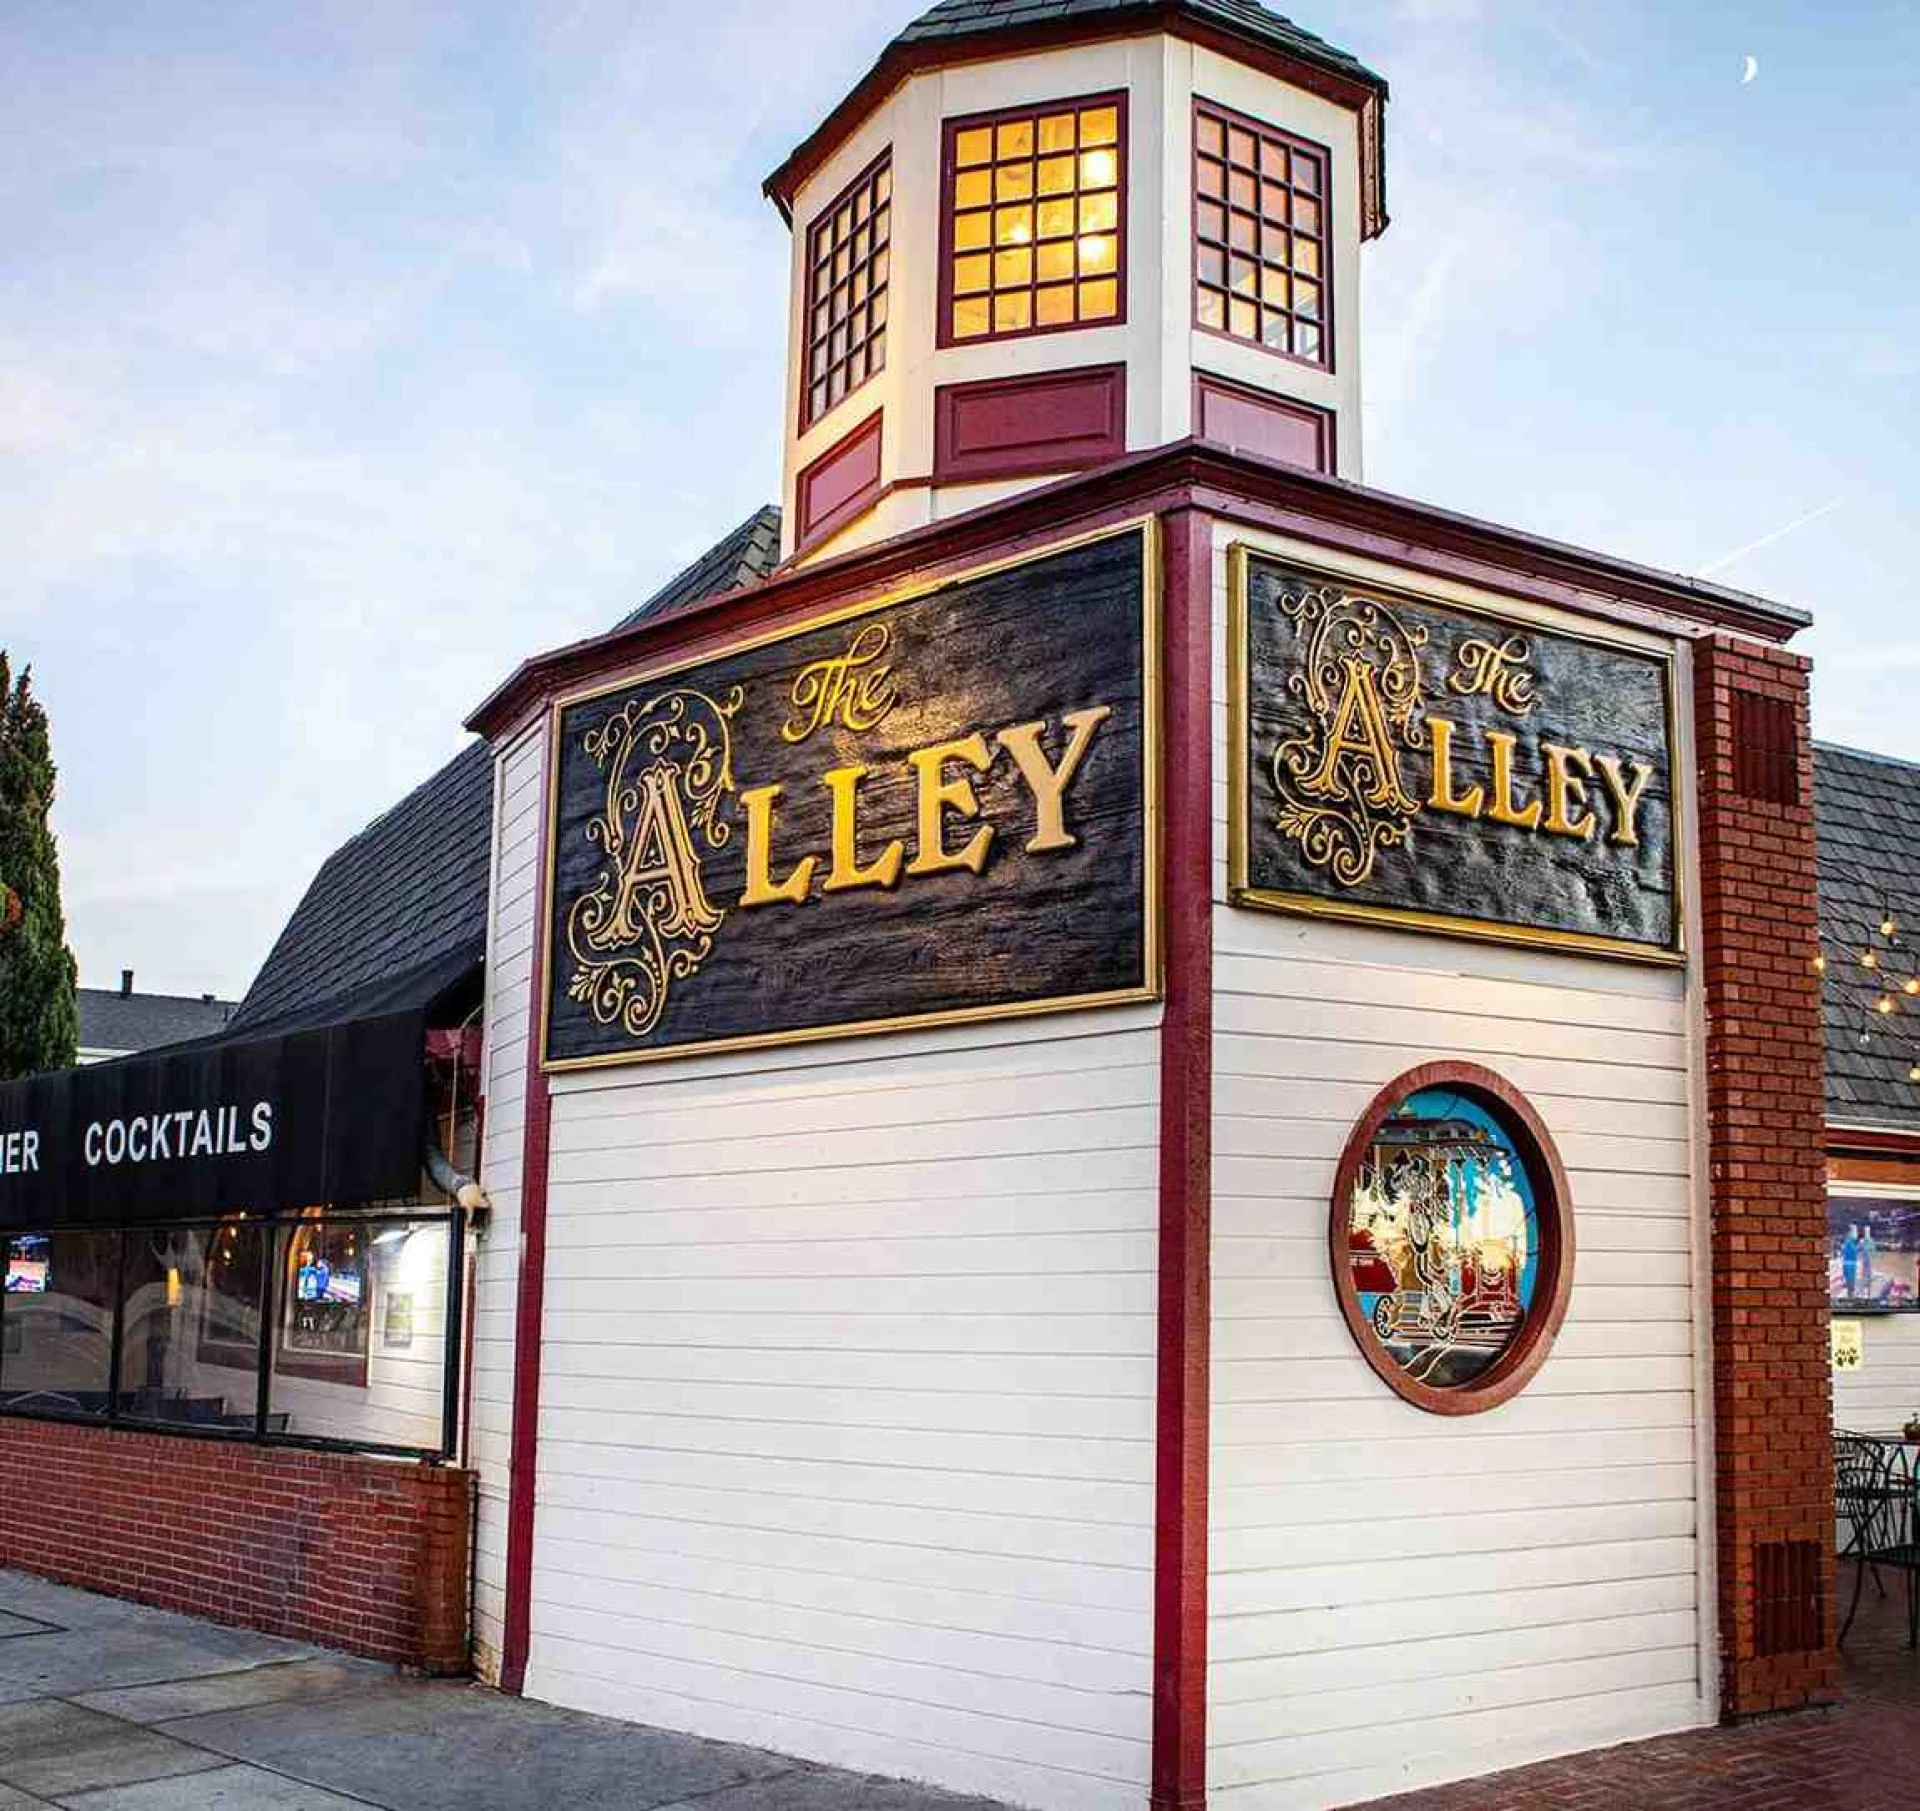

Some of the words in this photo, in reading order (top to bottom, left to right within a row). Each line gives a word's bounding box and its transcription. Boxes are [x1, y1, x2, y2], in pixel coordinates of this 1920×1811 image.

[780, 623, 897, 744] The
[1448, 637, 1540, 716] The
[1295, 652, 1654, 847] ALLEY
[589, 706, 1112, 952] ALLEY
[84, 1100, 273, 1167] COCKTAILS
